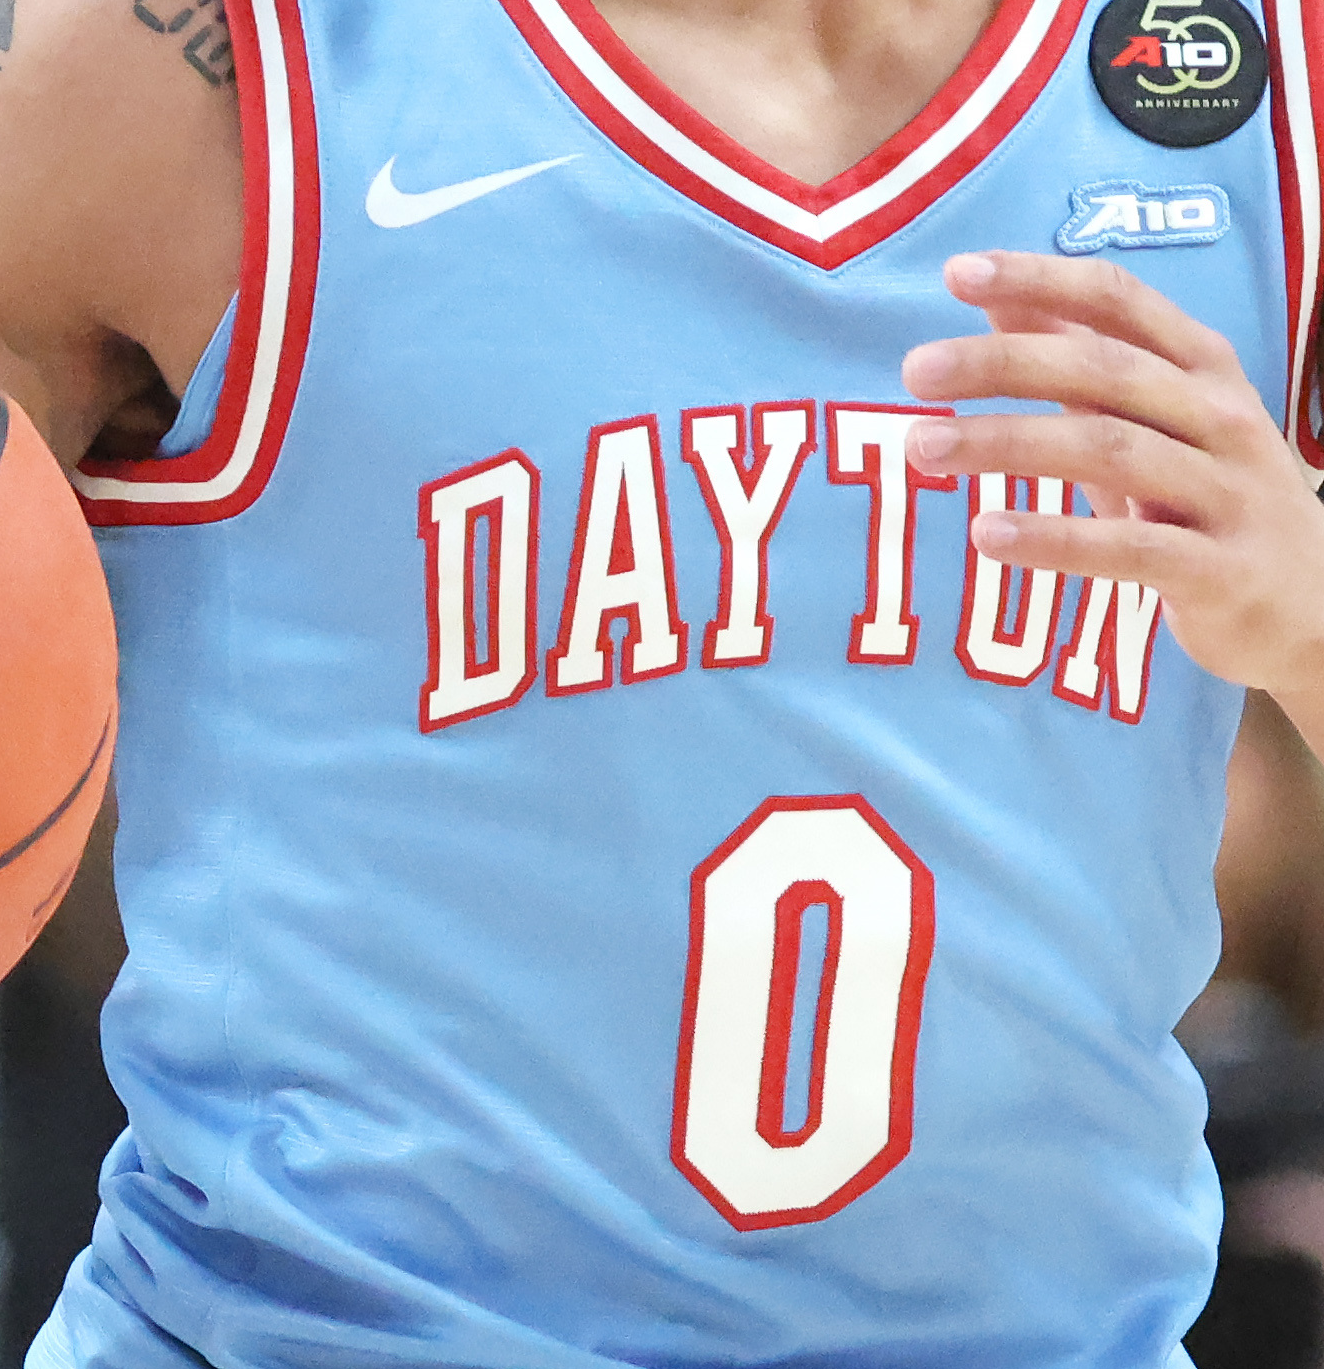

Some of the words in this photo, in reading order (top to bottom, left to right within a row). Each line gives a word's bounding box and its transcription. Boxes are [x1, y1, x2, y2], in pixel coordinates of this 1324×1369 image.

[1110, 36, 1227, 68] A10
[1135, 98, 1240, 109] ANNIVERSARY
[1074, 194, 1216, 239] A10
[670, 792, 936, 1233] 0
